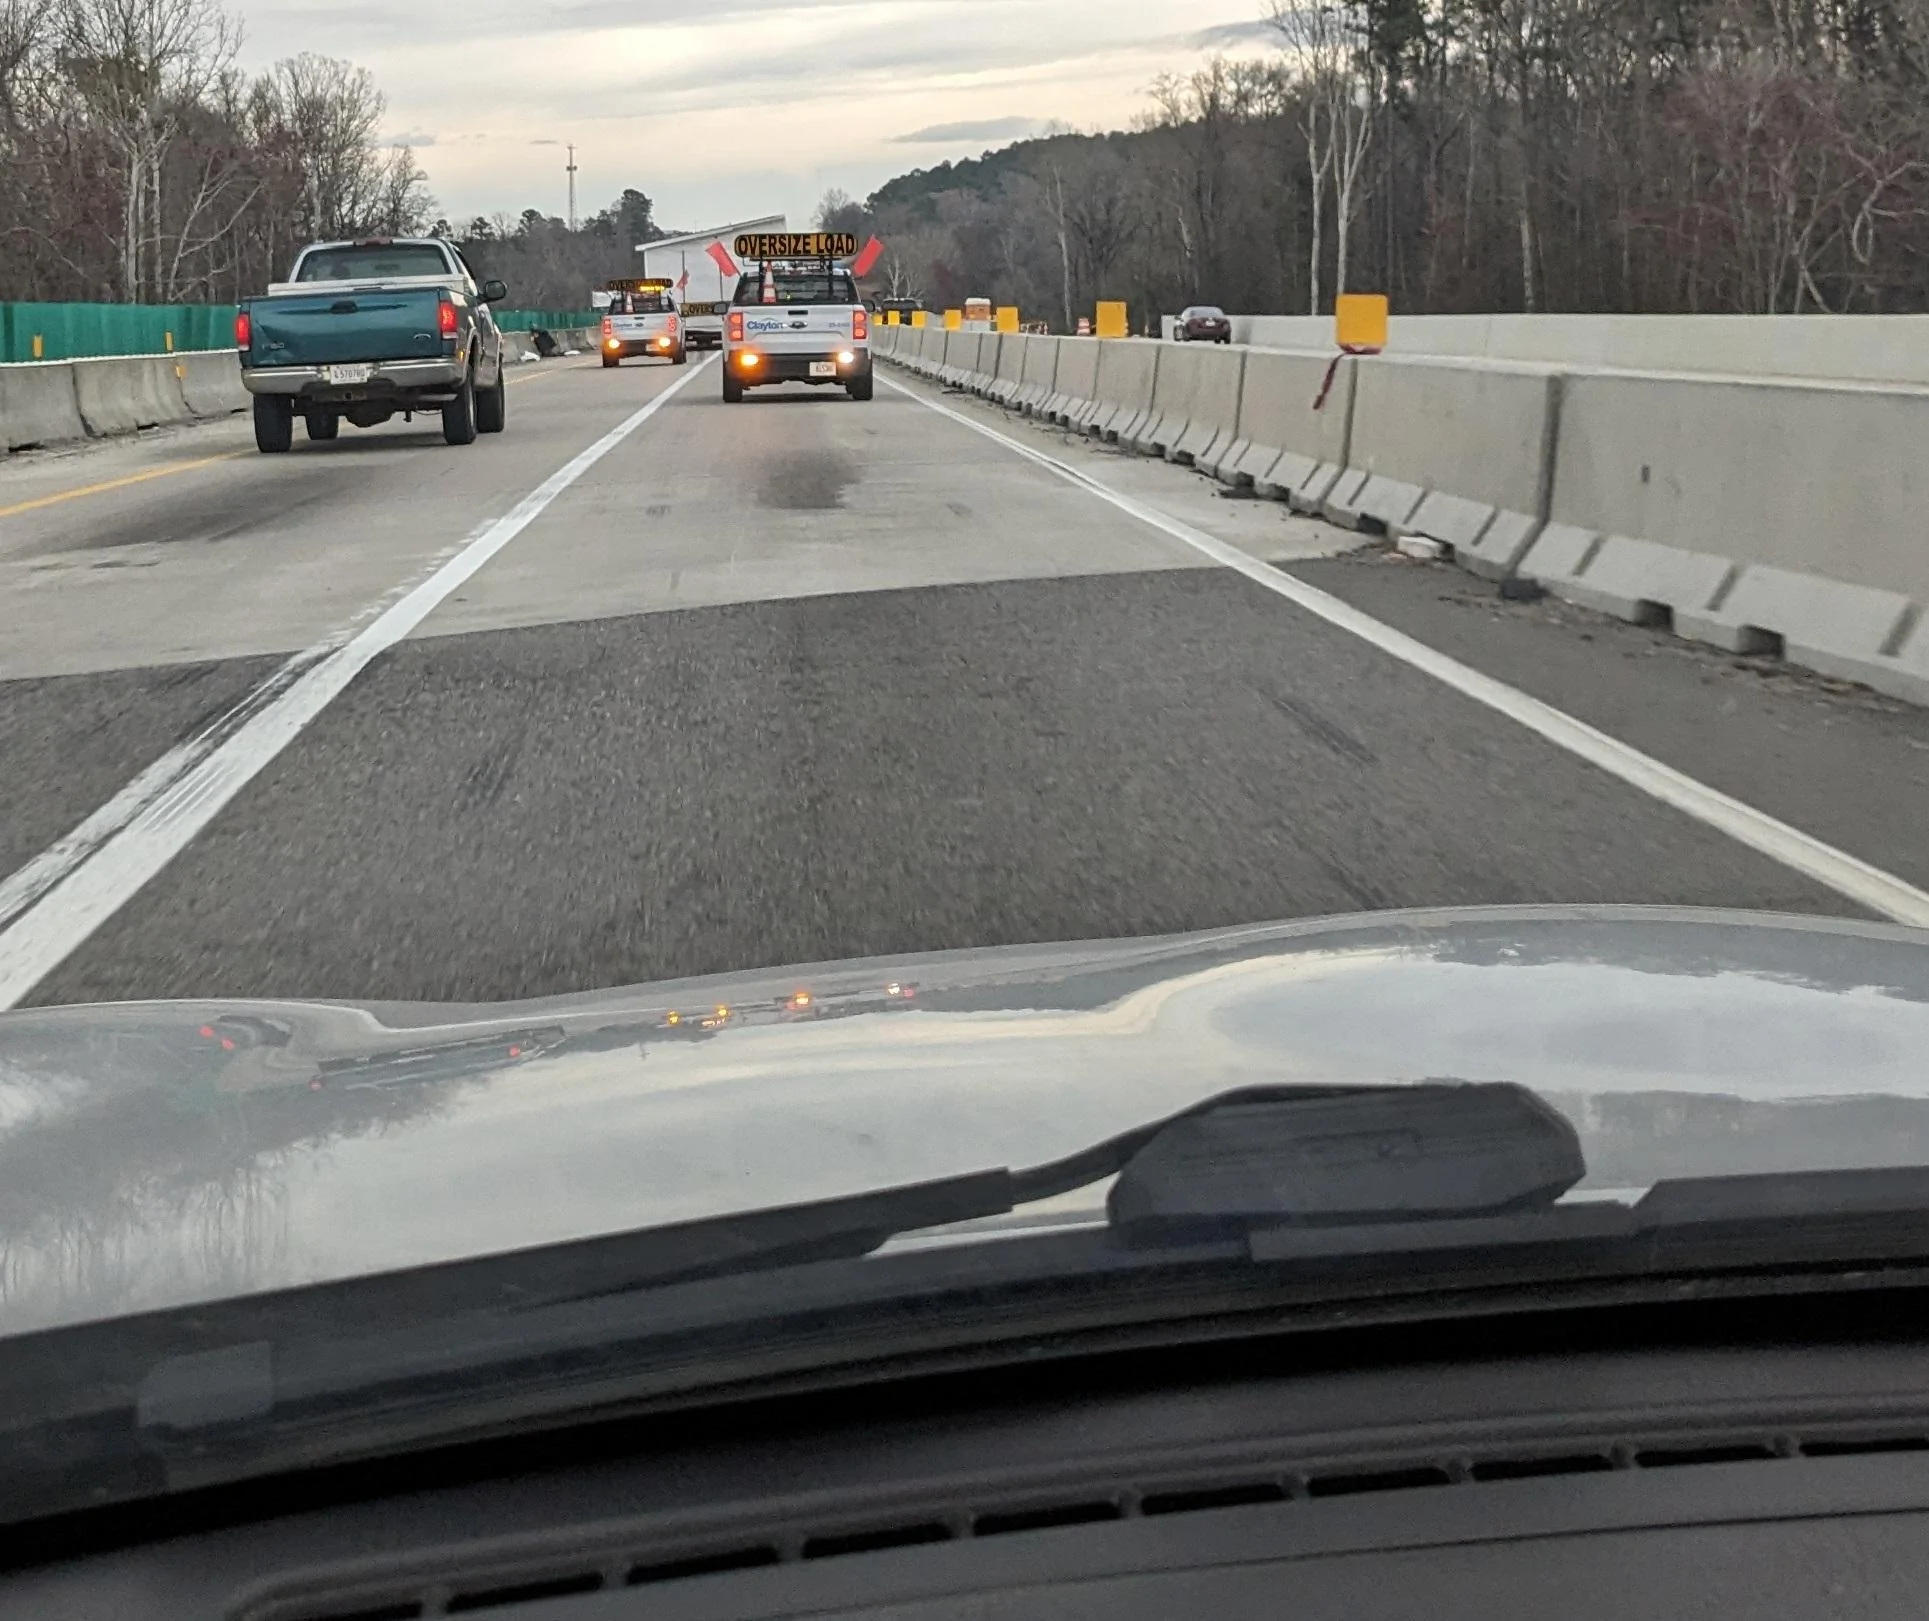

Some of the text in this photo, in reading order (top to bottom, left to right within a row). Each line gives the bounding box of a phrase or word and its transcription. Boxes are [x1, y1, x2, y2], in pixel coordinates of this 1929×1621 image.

[738, 233, 855, 255] OVERSIZE LOAD
[747, 320, 784, 331] Clayton
